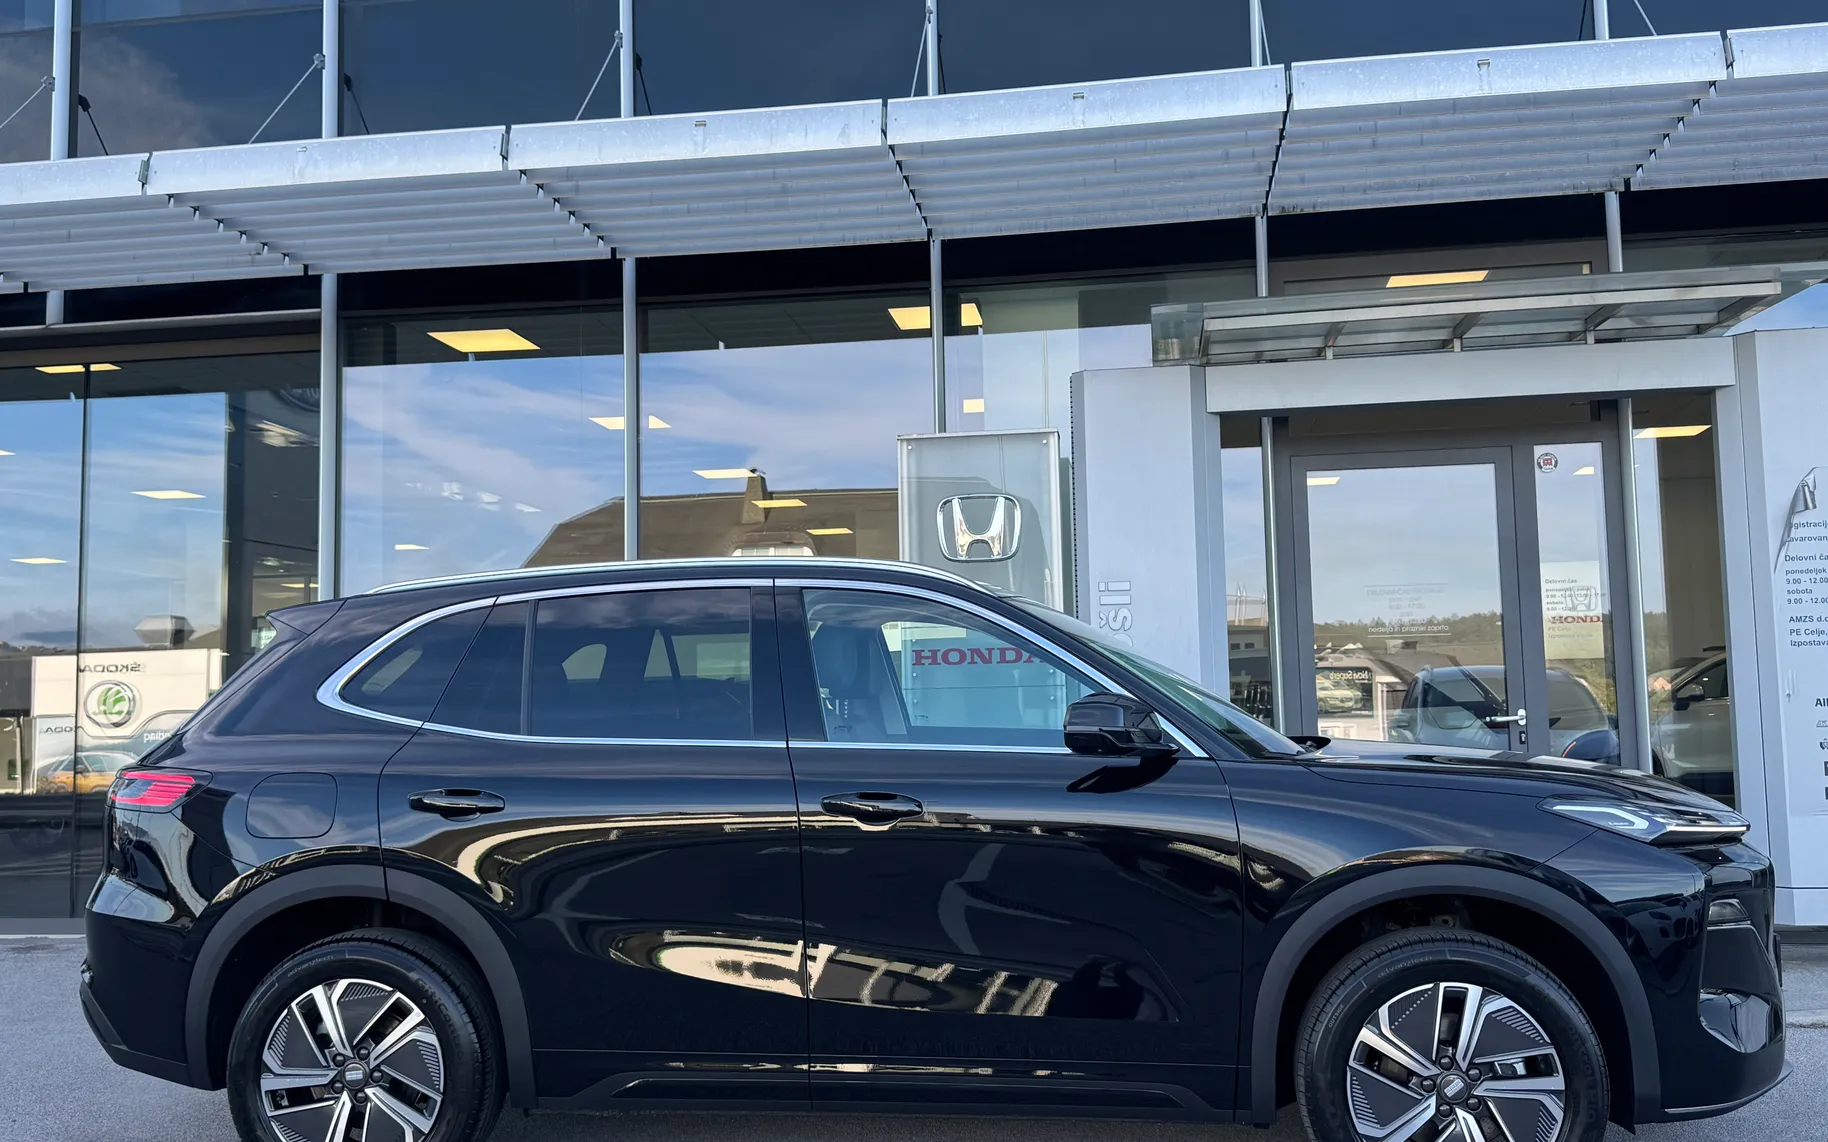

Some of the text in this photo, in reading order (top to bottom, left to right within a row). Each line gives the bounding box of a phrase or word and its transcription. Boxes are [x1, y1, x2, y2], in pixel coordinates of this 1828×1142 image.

[1784, 553, 1817, 562] Delovni
[1785, 567, 1827, 576] ponedeljek
[1785, 577, 1802, 585] 9.00
[1786, 588, 1813, 596] sobota
[1786, 597, 1803, 605] 9.00
[1550, 614, 1604, 625] HOND
[1788, 615, 1815, 623] AMZS
[1789, 628, 1802, 636] PE
